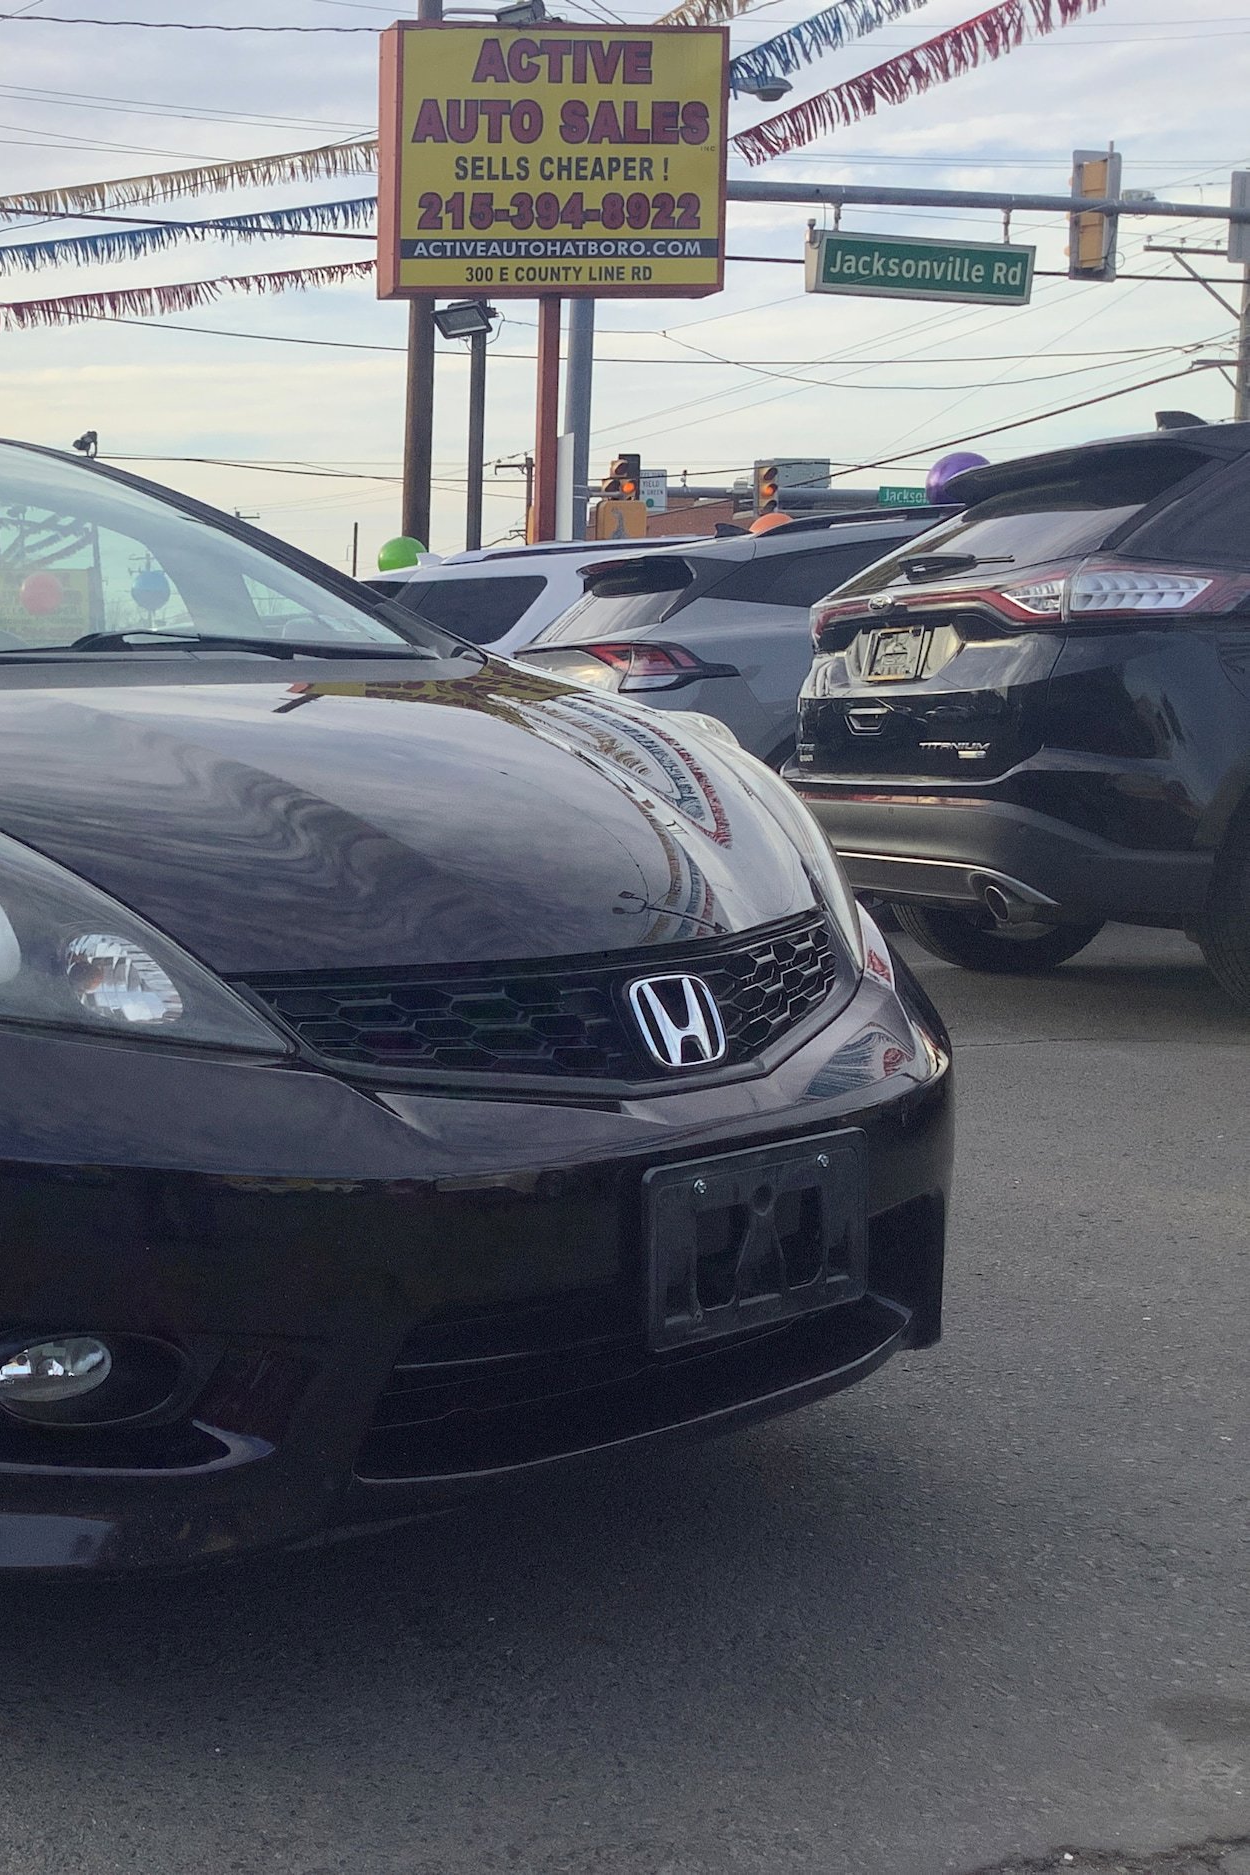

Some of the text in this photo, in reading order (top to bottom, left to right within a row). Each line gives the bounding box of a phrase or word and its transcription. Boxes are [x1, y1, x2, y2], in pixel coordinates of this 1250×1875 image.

[472, 38, 653, 84] ACTIVE
[411, 98, 710, 145] AUTO SALES
[454, 156, 530, 181] SELLS
[539, 156, 654, 181] CHEAPER
[417, 191, 701, 231] 215-394-8922
[413, 240, 702, 257] ACTIVEAUTOHATBORO.COM
[465, 265, 653, 283] 300 E COUNTY LINE RD
[829, 250, 1022, 286] Jacksonville Rd
[642, 480, 660, 488] YIELD
